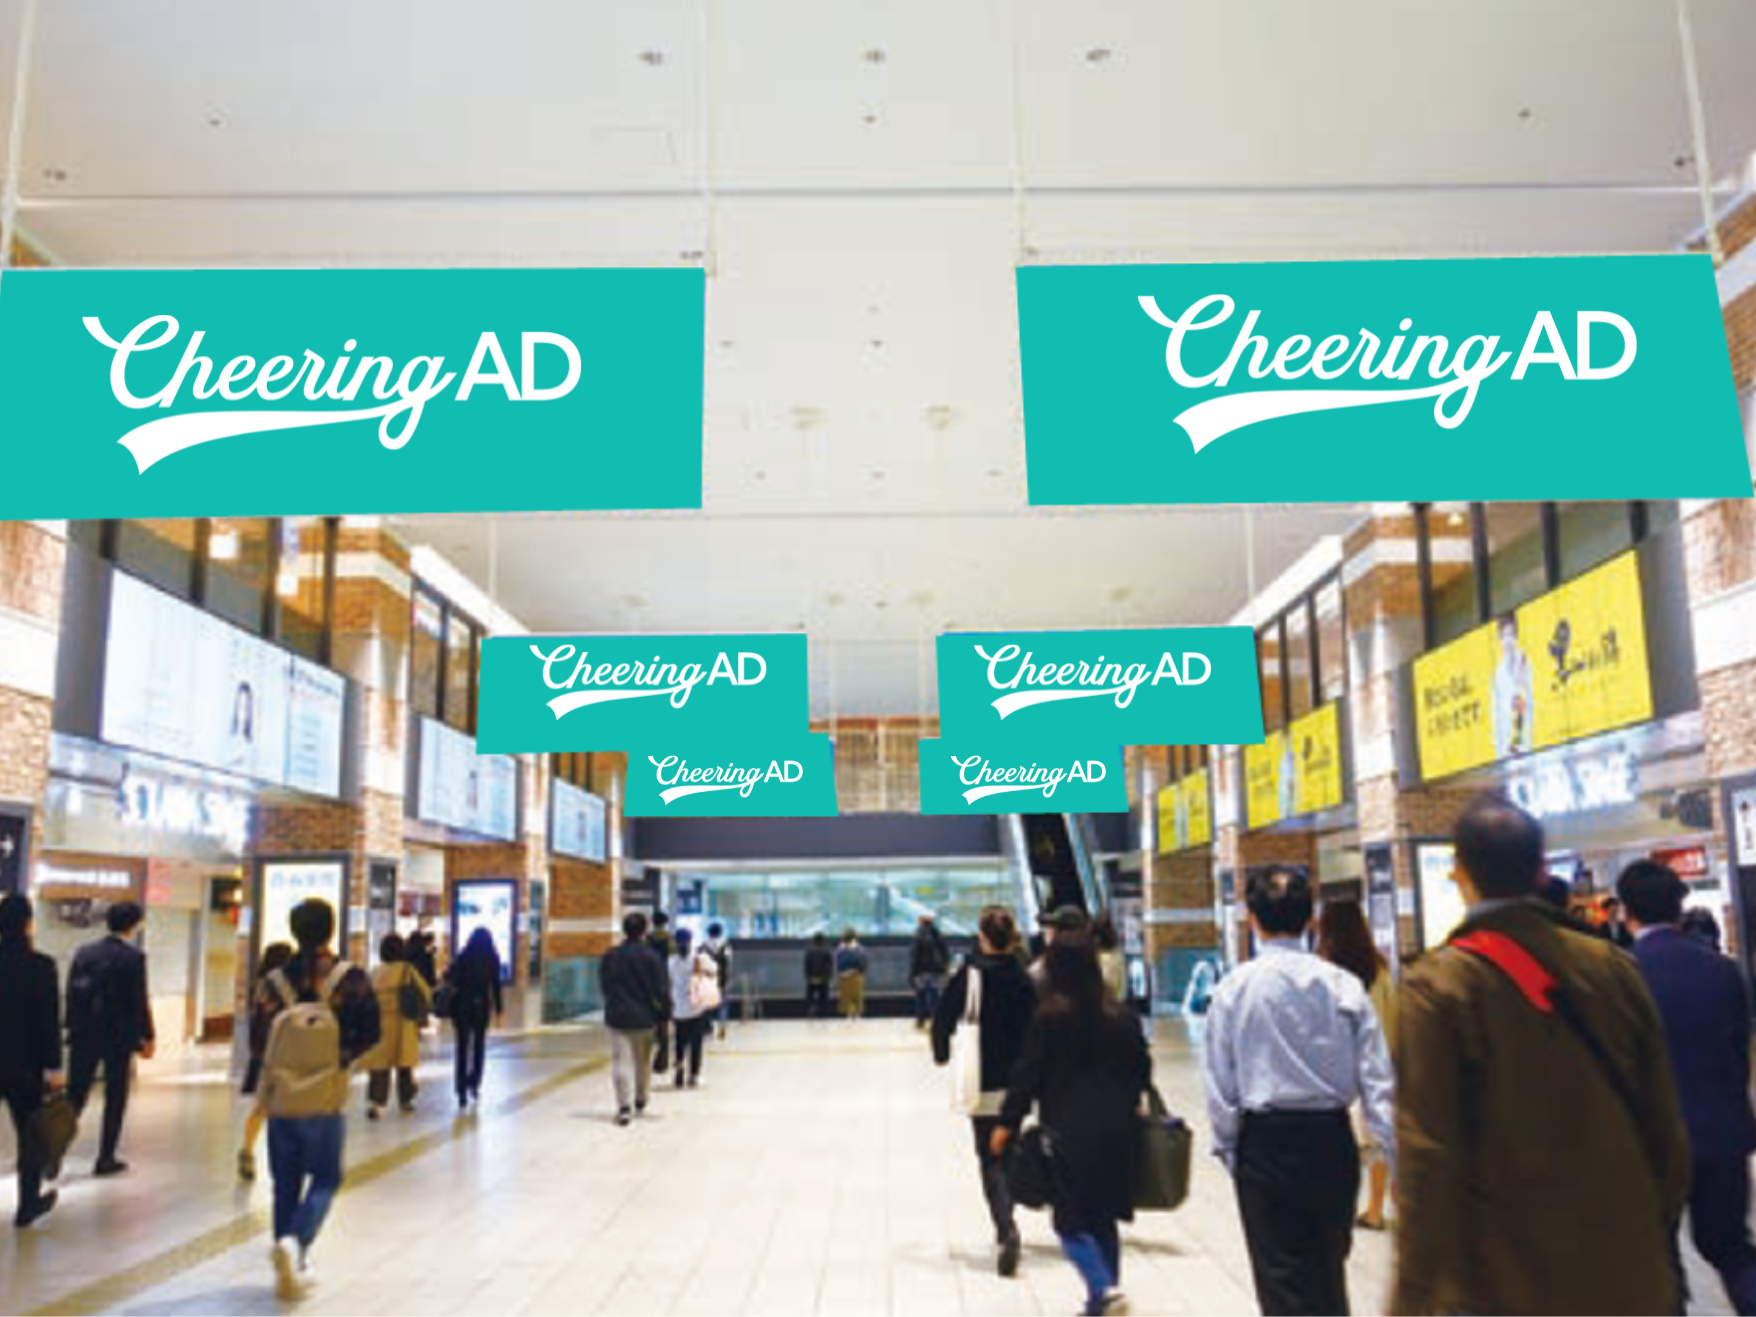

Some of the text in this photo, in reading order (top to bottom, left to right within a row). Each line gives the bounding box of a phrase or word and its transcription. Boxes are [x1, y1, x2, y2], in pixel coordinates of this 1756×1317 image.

[83, 315, 581, 475] Cheering AD
[1138, 294, 1637, 454] Cheering AD
[530, 645, 766, 720] Cheering AD
[974, 645, 1211, 720] Cheering AD
[648, 756, 803, 805] Cheering AD
[951, 756, 1106, 805] Cheering AD
